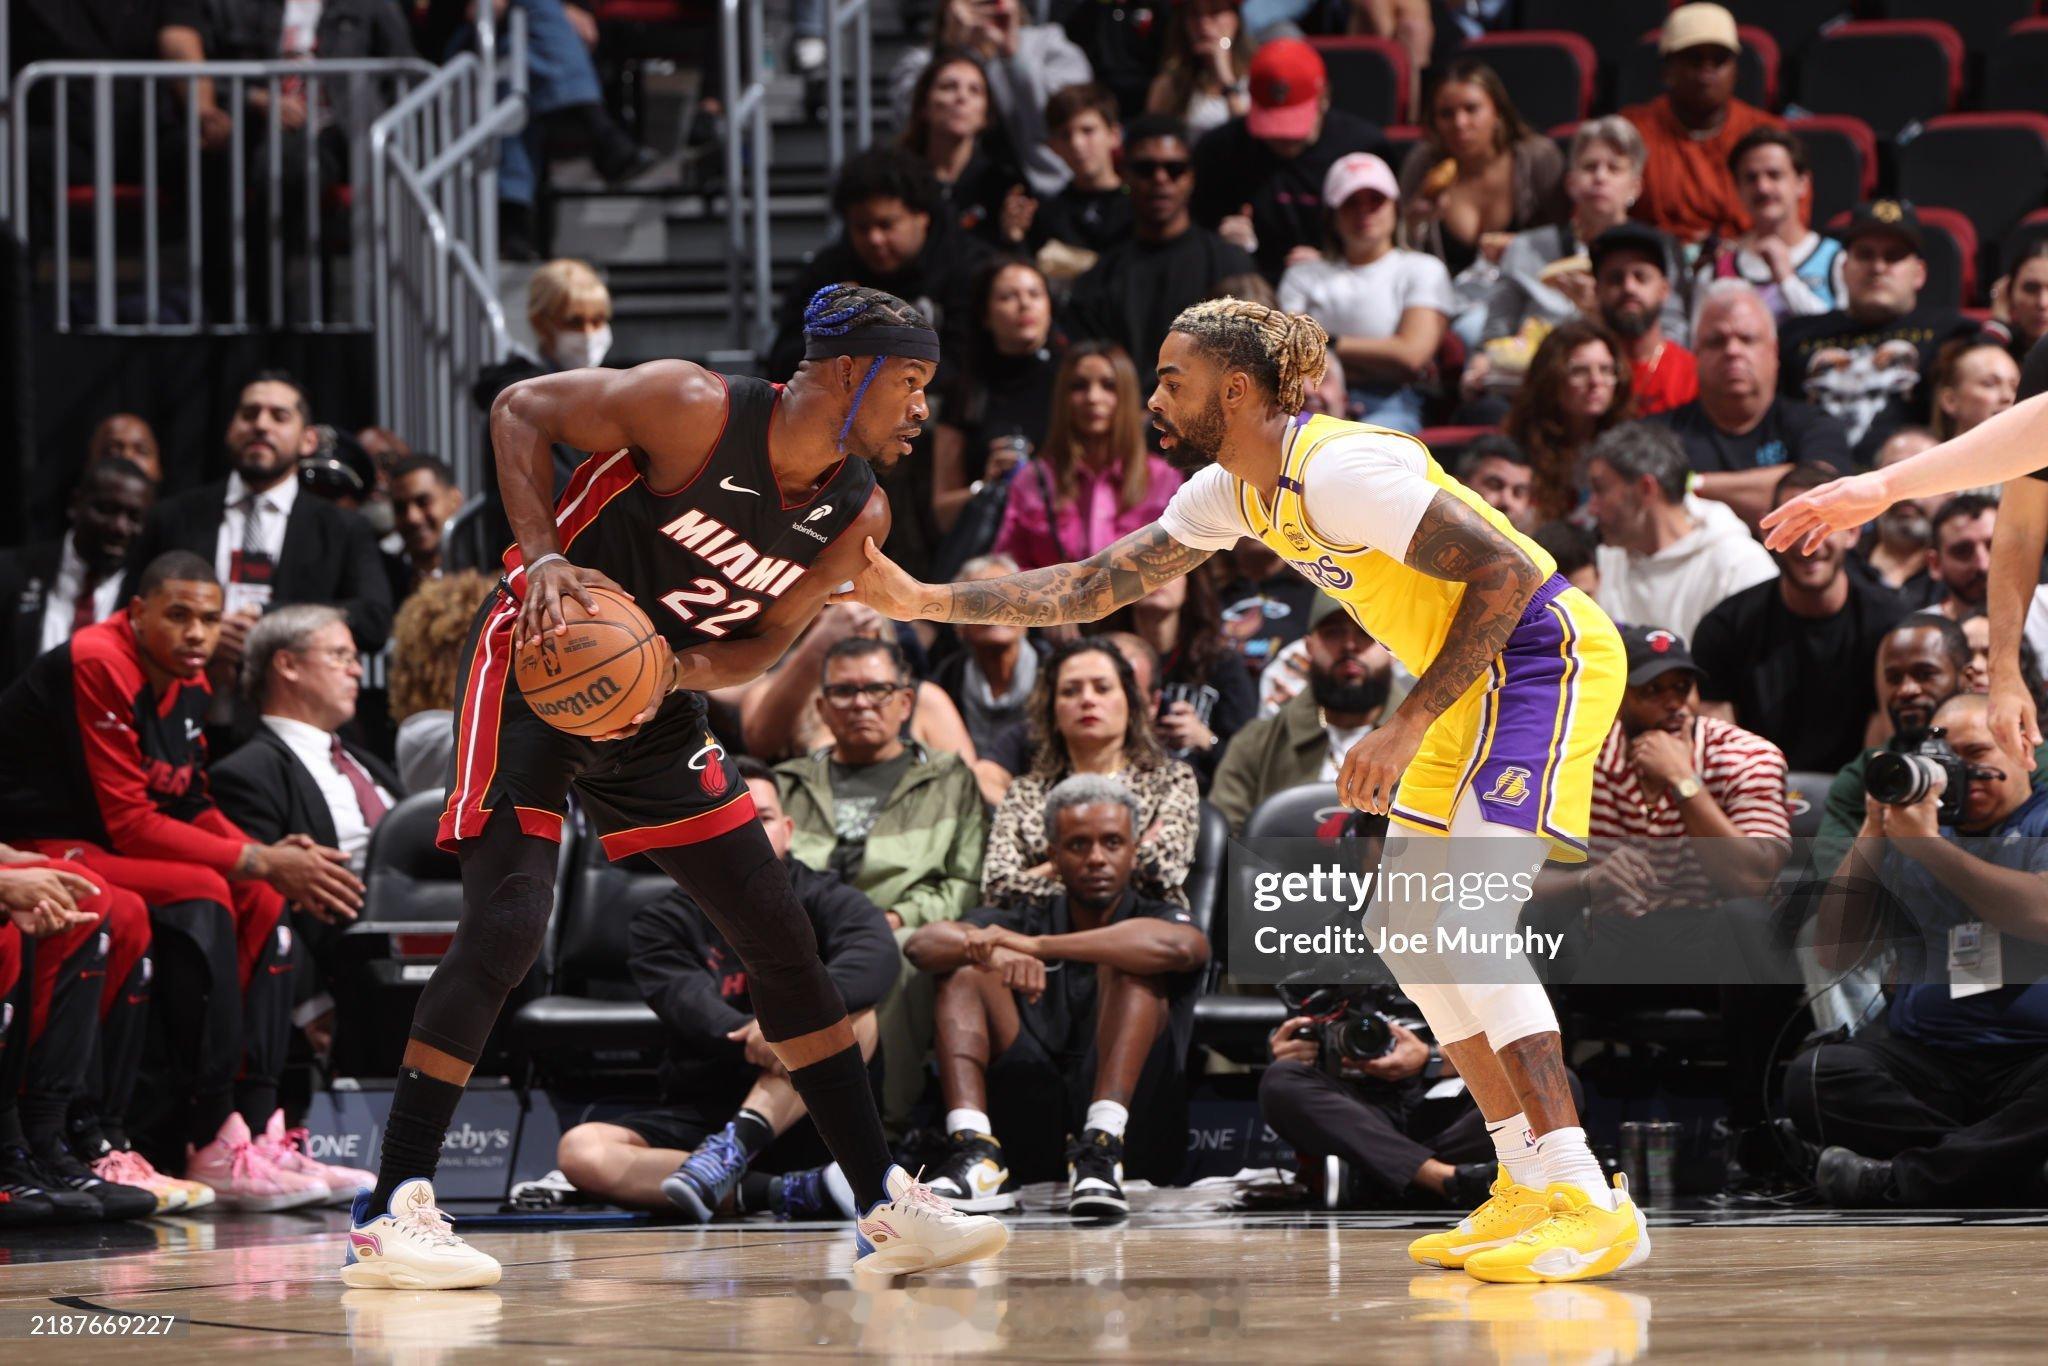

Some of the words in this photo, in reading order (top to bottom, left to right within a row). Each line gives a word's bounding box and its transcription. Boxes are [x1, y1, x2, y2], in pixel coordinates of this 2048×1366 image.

[658, 507, 809, 598] MIAMI
[657, 577, 762, 638] 22
[532, 675, 622, 716] Wilson
